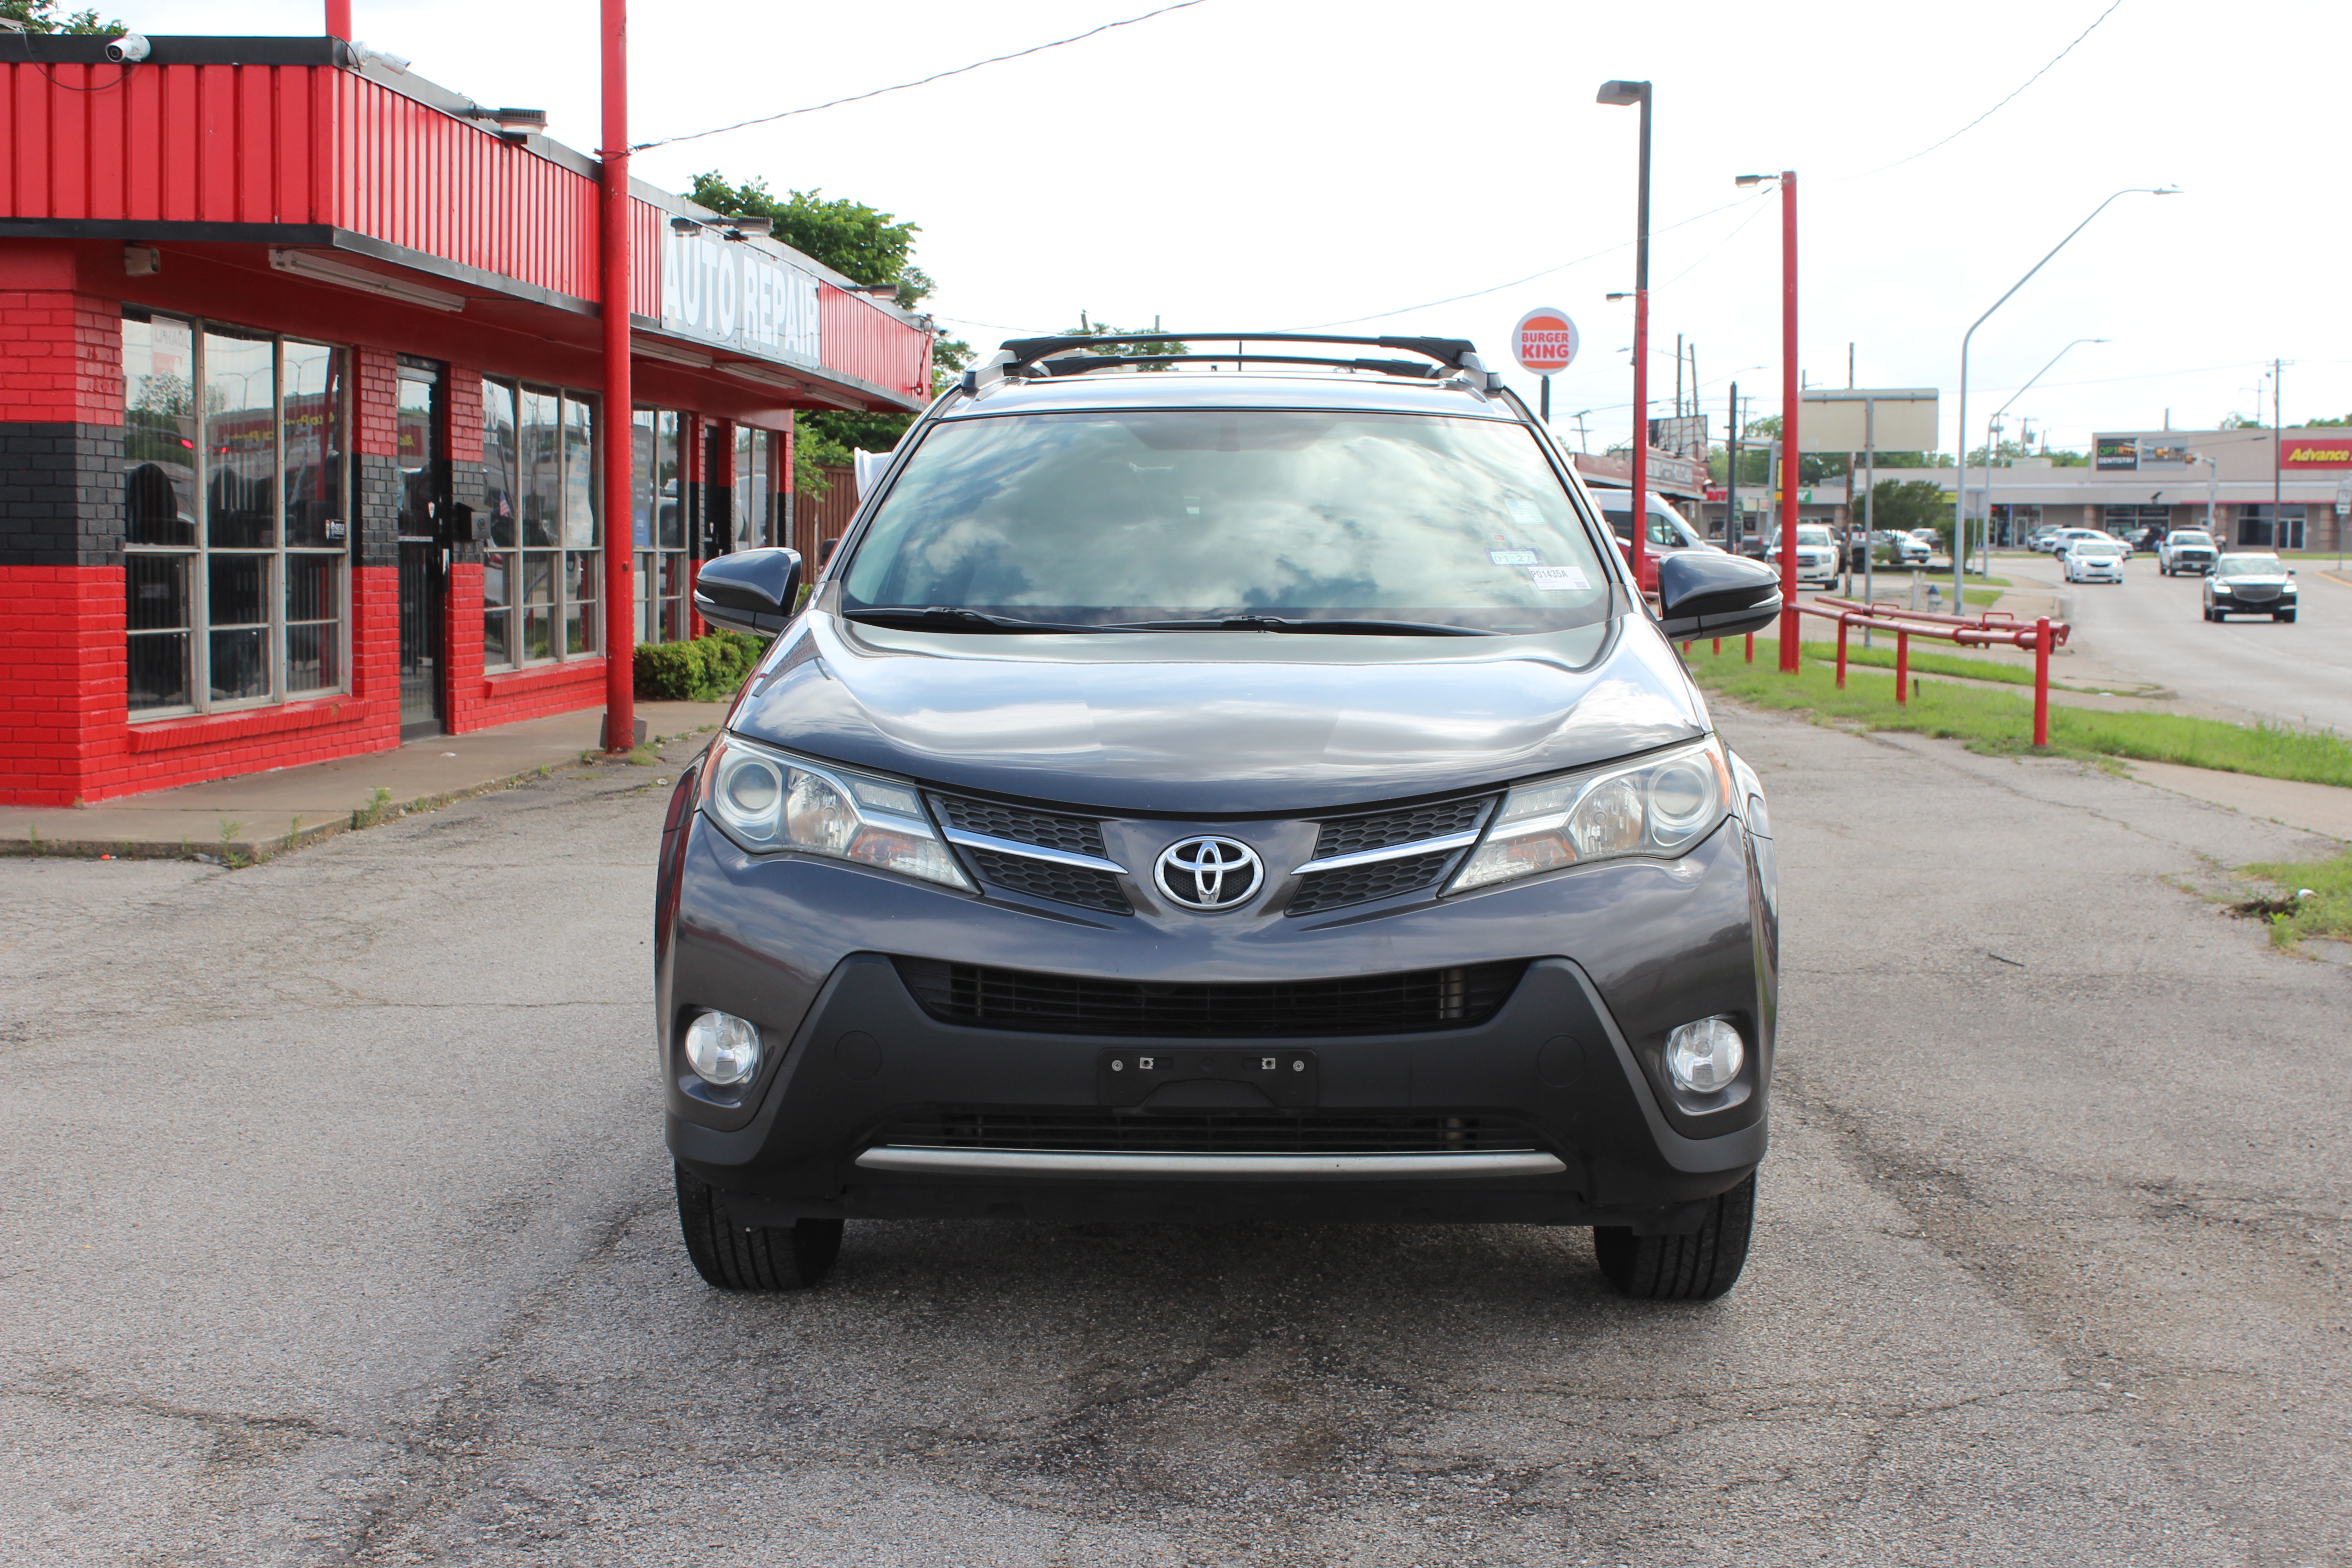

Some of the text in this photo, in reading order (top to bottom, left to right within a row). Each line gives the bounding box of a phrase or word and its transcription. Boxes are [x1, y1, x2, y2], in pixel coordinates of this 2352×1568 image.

[662, 229, 819, 358] AUTO REPAIR
[1522, 333, 1568, 343] BURGER
[1522, 344, 1568, 358] KING
[2097, 456, 2136, 465] DENTISTRY
[2288, 448, 2350, 461] Advance
